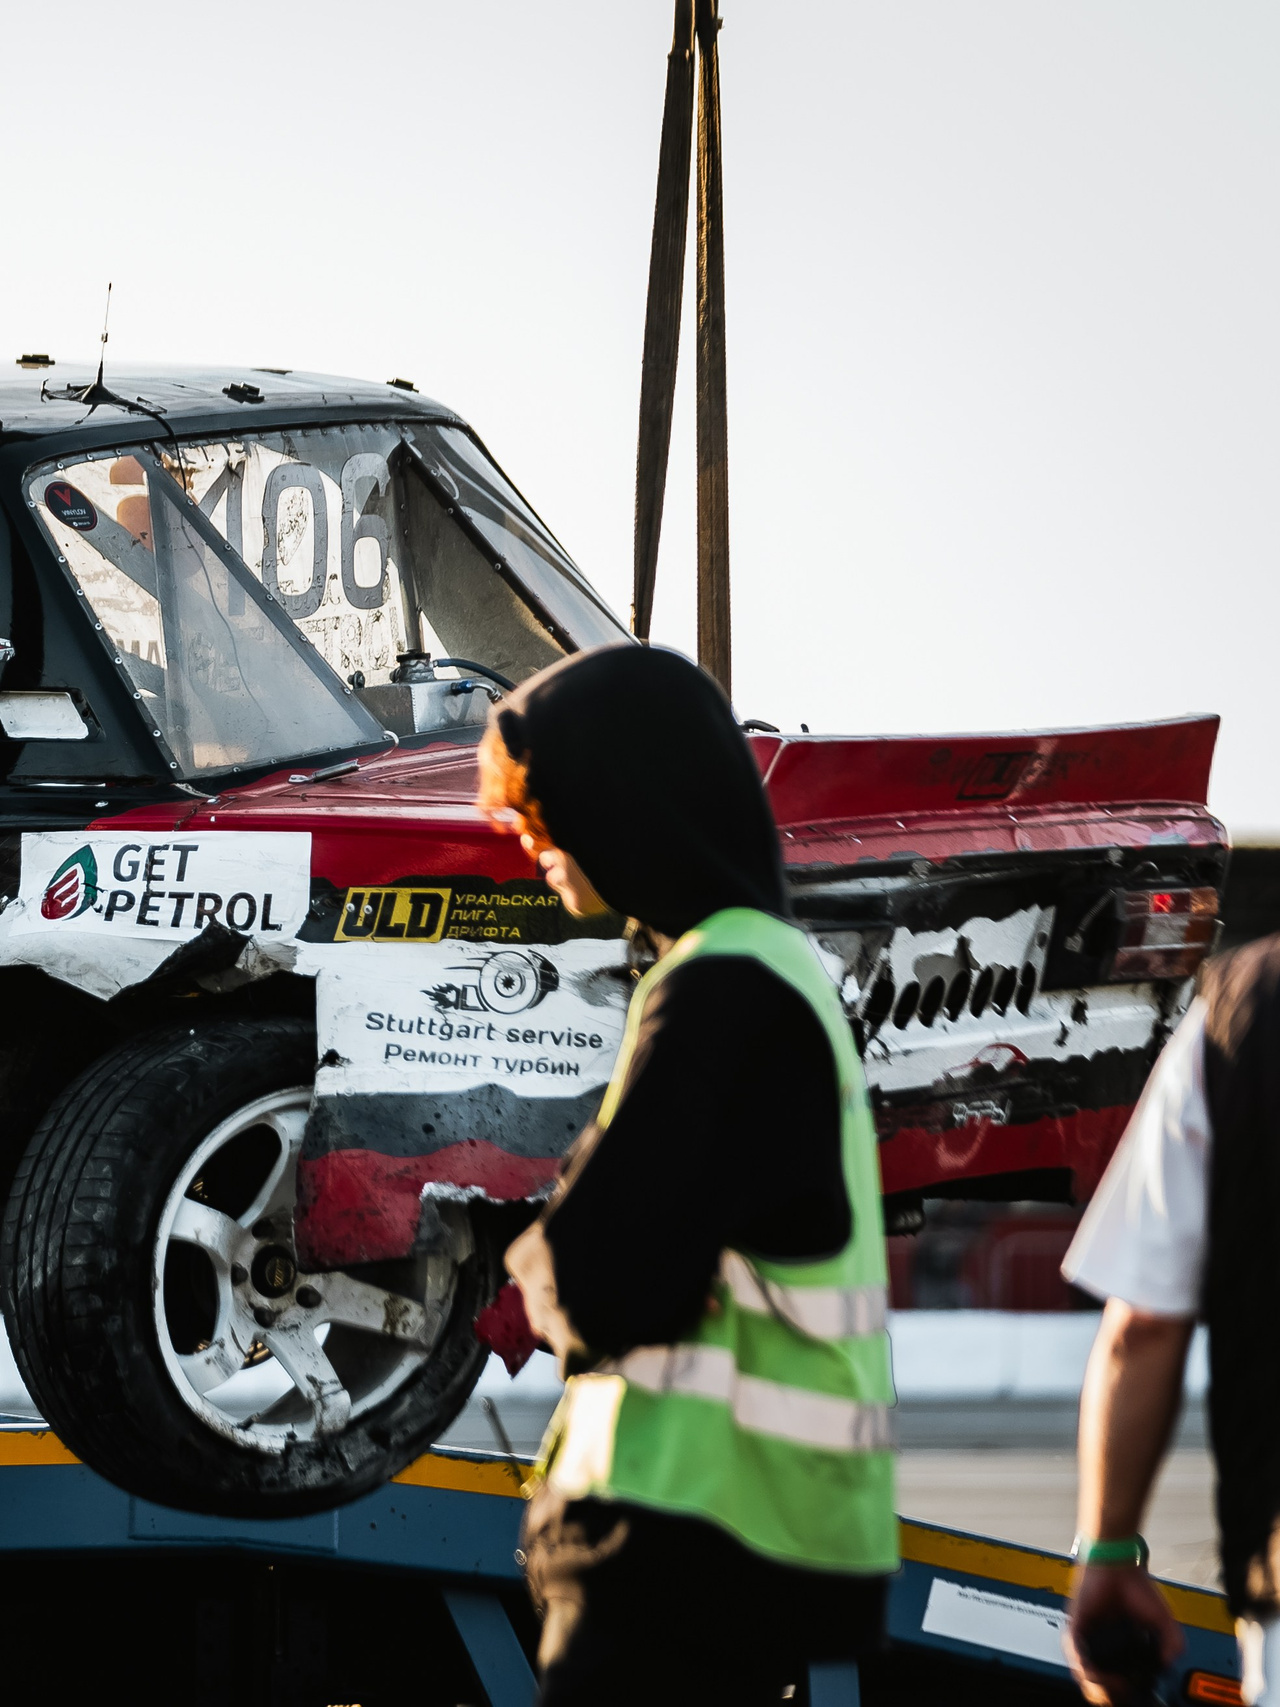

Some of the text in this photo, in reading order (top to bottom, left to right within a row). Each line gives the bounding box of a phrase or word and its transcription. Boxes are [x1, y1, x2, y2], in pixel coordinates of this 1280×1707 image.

[197, 452, 390, 619] 106
[112, 843, 199, 882] GET
[104, 890, 282, 932] PETROL
[342, 892, 445, 938] ULD
[451, 909, 497, 922] ЛИГА
[455, 894, 558, 907] УРАЛЬСКАЯ
[446, 925, 521, 939] ДРИФТА
[365, 1012, 603, 1049] Stuttgart servise
[385, 1043, 580, 1076] Ремонт турбин
